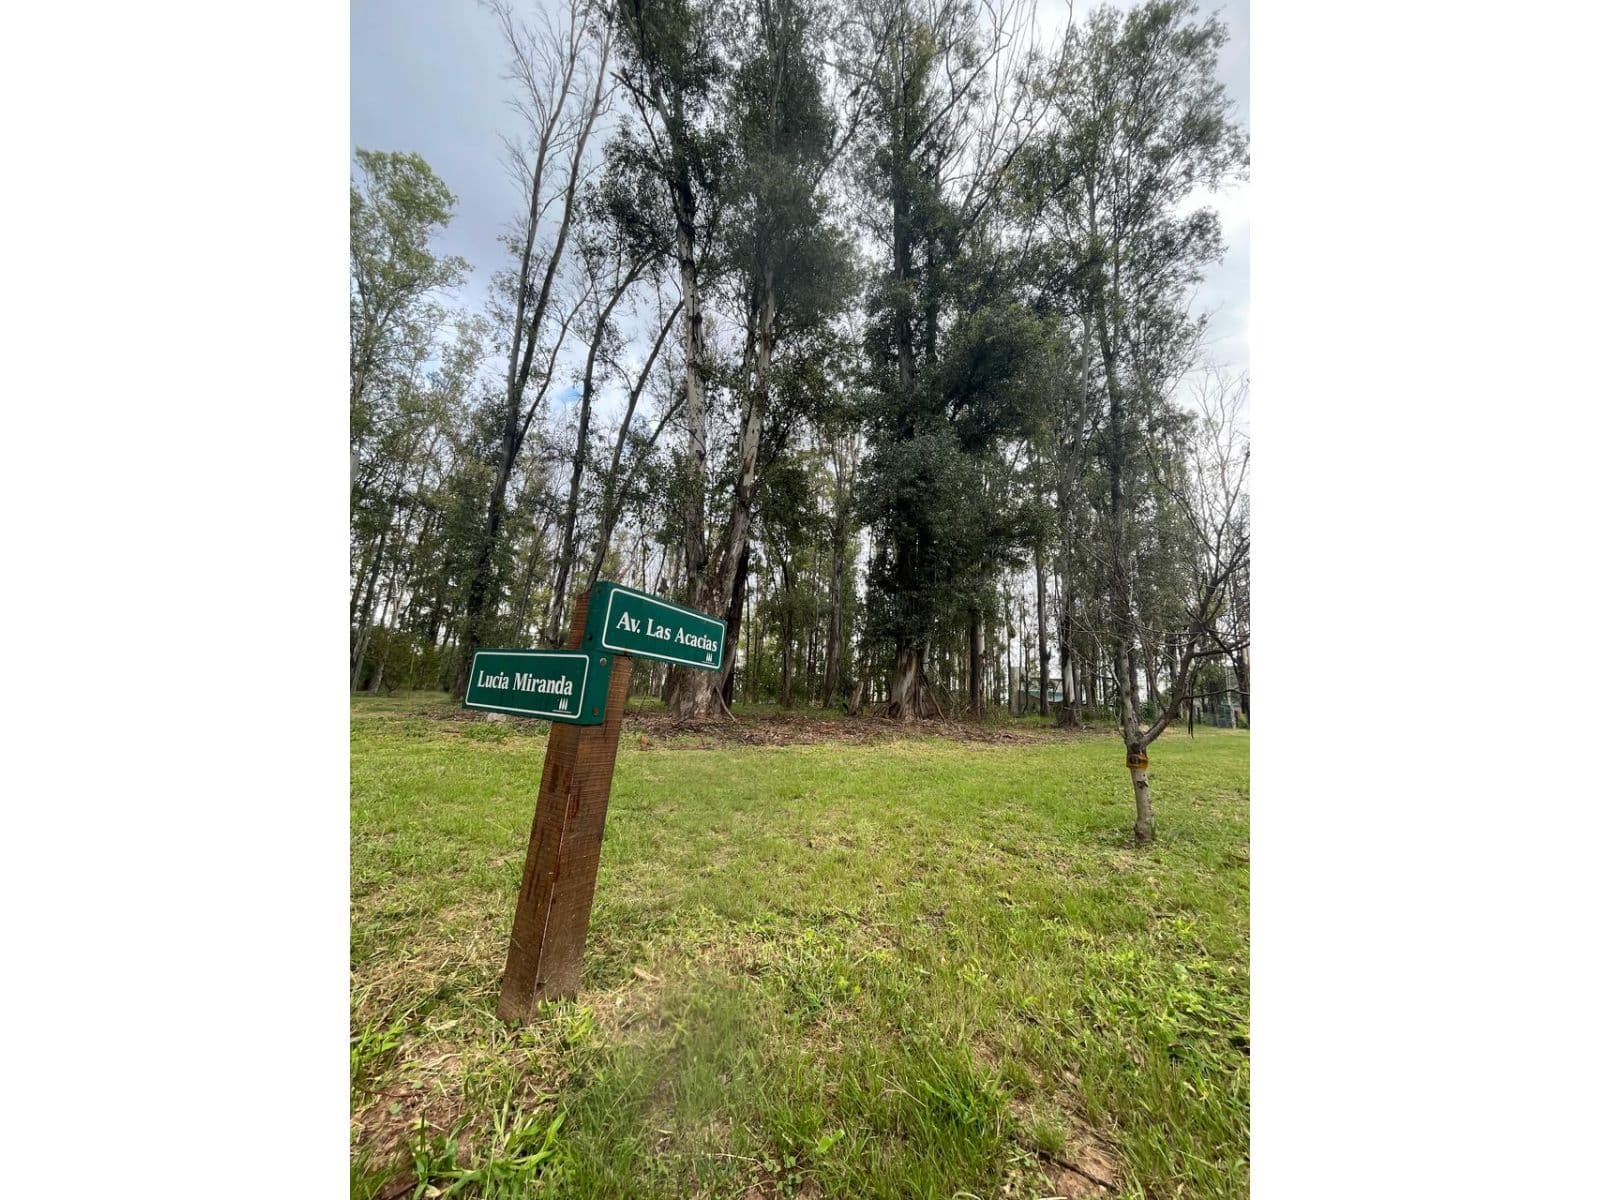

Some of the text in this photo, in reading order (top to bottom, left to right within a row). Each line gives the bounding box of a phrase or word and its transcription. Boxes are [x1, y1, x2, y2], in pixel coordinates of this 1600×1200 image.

[616, 611, 718, 652] Av. Las Acacias
[477, 671, 573, 695] Lucia Miranda
